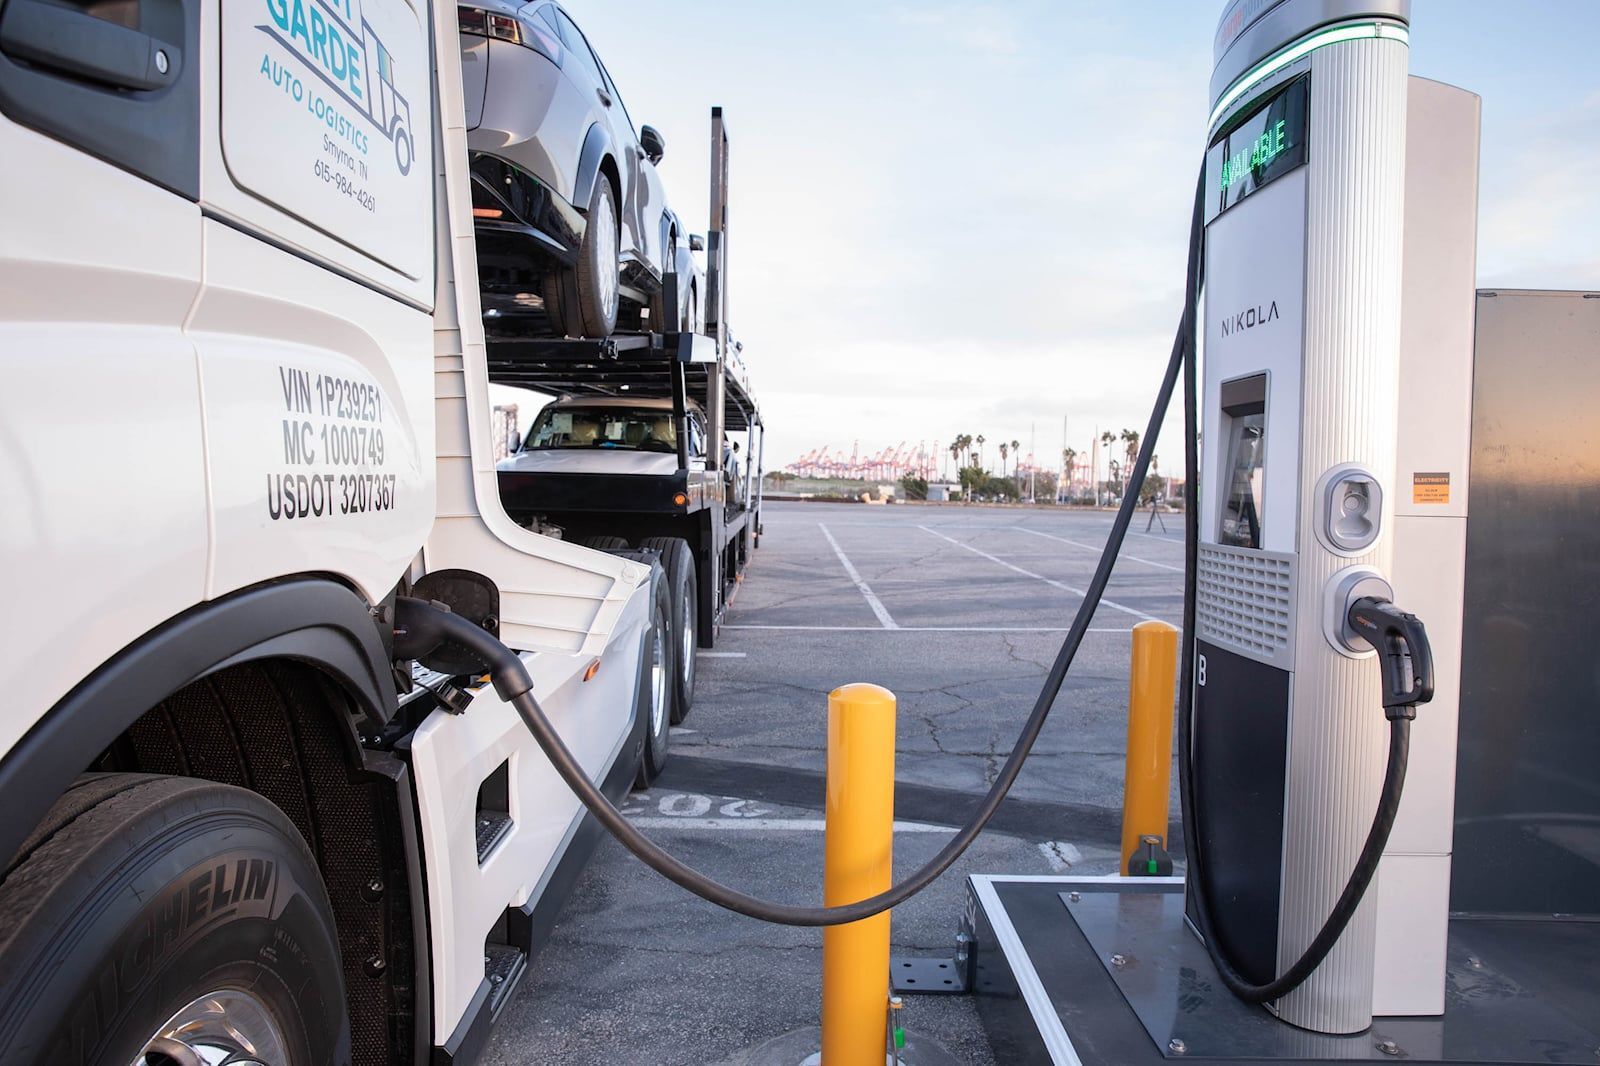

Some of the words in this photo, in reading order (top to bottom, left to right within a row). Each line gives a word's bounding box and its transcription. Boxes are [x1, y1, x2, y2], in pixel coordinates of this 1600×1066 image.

[260, 54, 303, 102] AUTO
[307, 90, 368, 155] LOGISTICS
[358, 160, 368, 181] TN
[1221, 119, 1285, 191] AVAILABLE
[314, 159, 376, 213] 615-984-4261
[1221, 300, 1279, 339] NIKOLA
[279, 366, 312, 414] VIN
[316, 373, 383, 423] 1P239251
[282, 419, 315, 466] MC
[320, 423, 385, 466] 1000749
[266, 473, 335, 521] USDOT
[339, 473, 397, 515] 3207367
[1199, 654, 1207, 687] B
